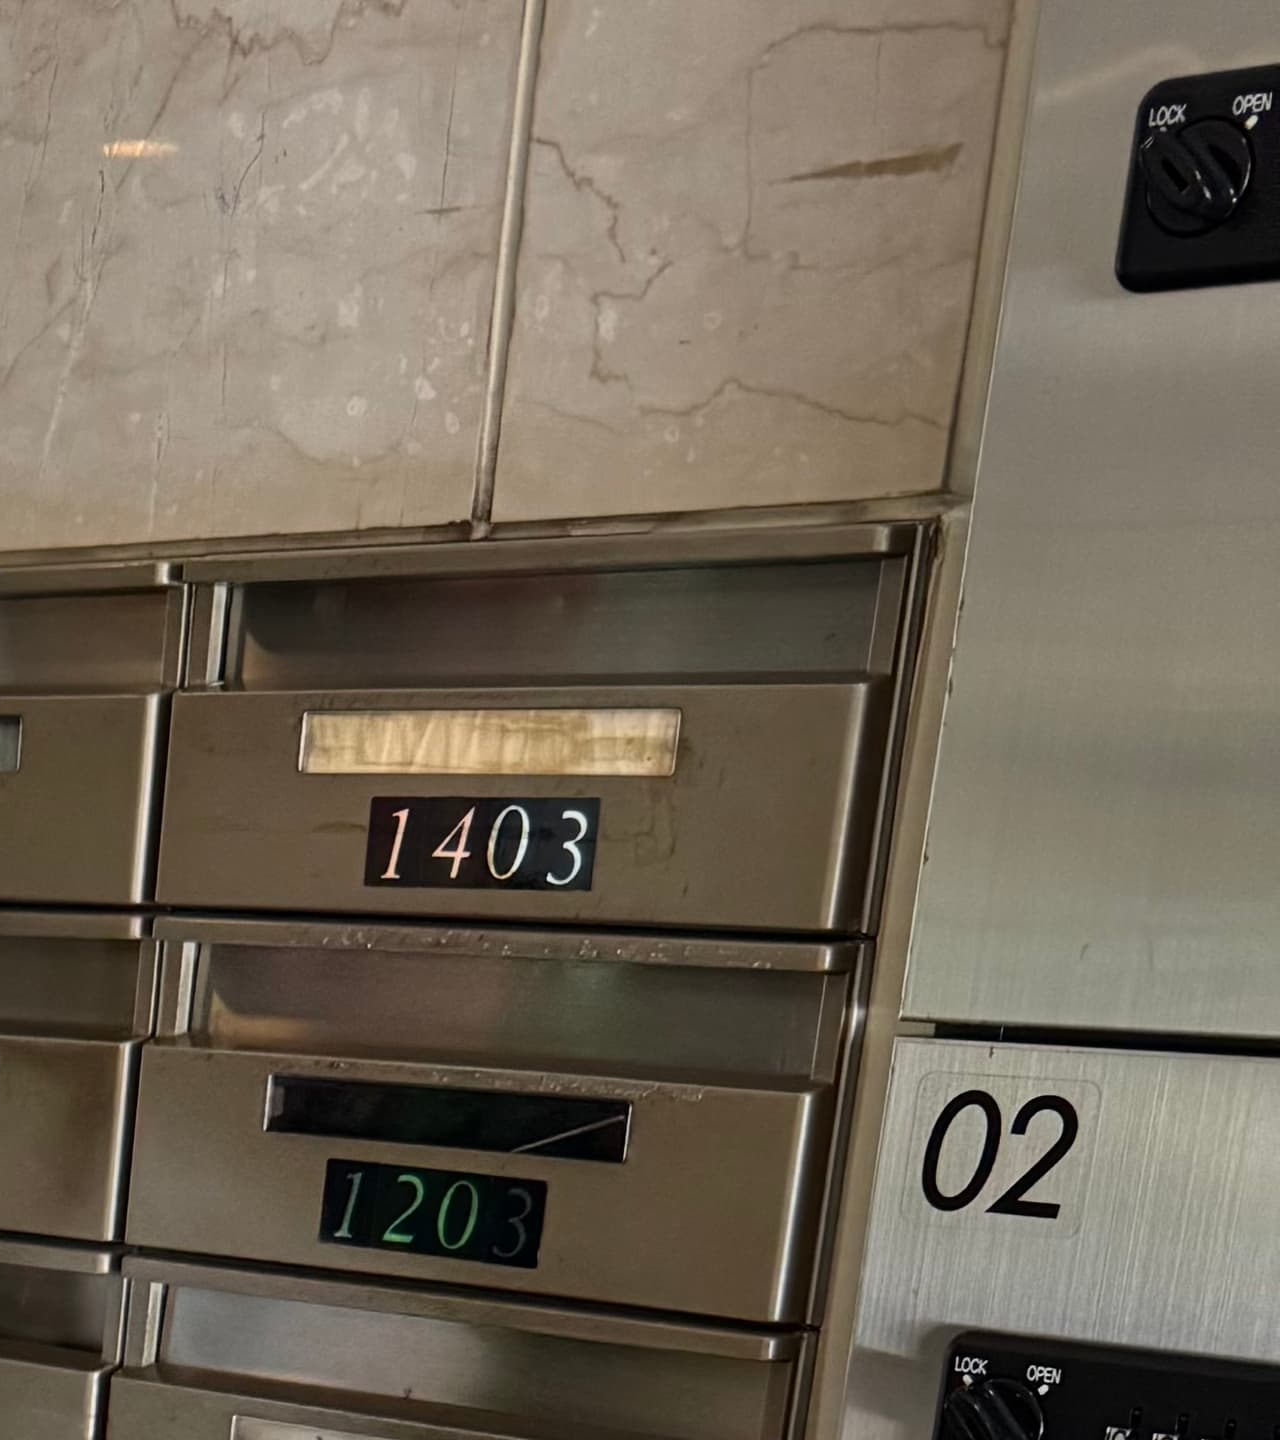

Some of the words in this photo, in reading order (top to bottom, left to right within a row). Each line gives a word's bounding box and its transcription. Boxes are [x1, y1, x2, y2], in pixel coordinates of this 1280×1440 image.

[1148, 103, 1187, 128] LOCK
[1232, 91, 1273, 116] OPEN
[379, 804, 589, 887] 1403
[920, 1088, 1080, 1220] 02
[333, 1170, 534, 1259] 1203
[953, 1356, 988, 1376] LOCK
[1026, 1364, 1062, 1386] OPEN
